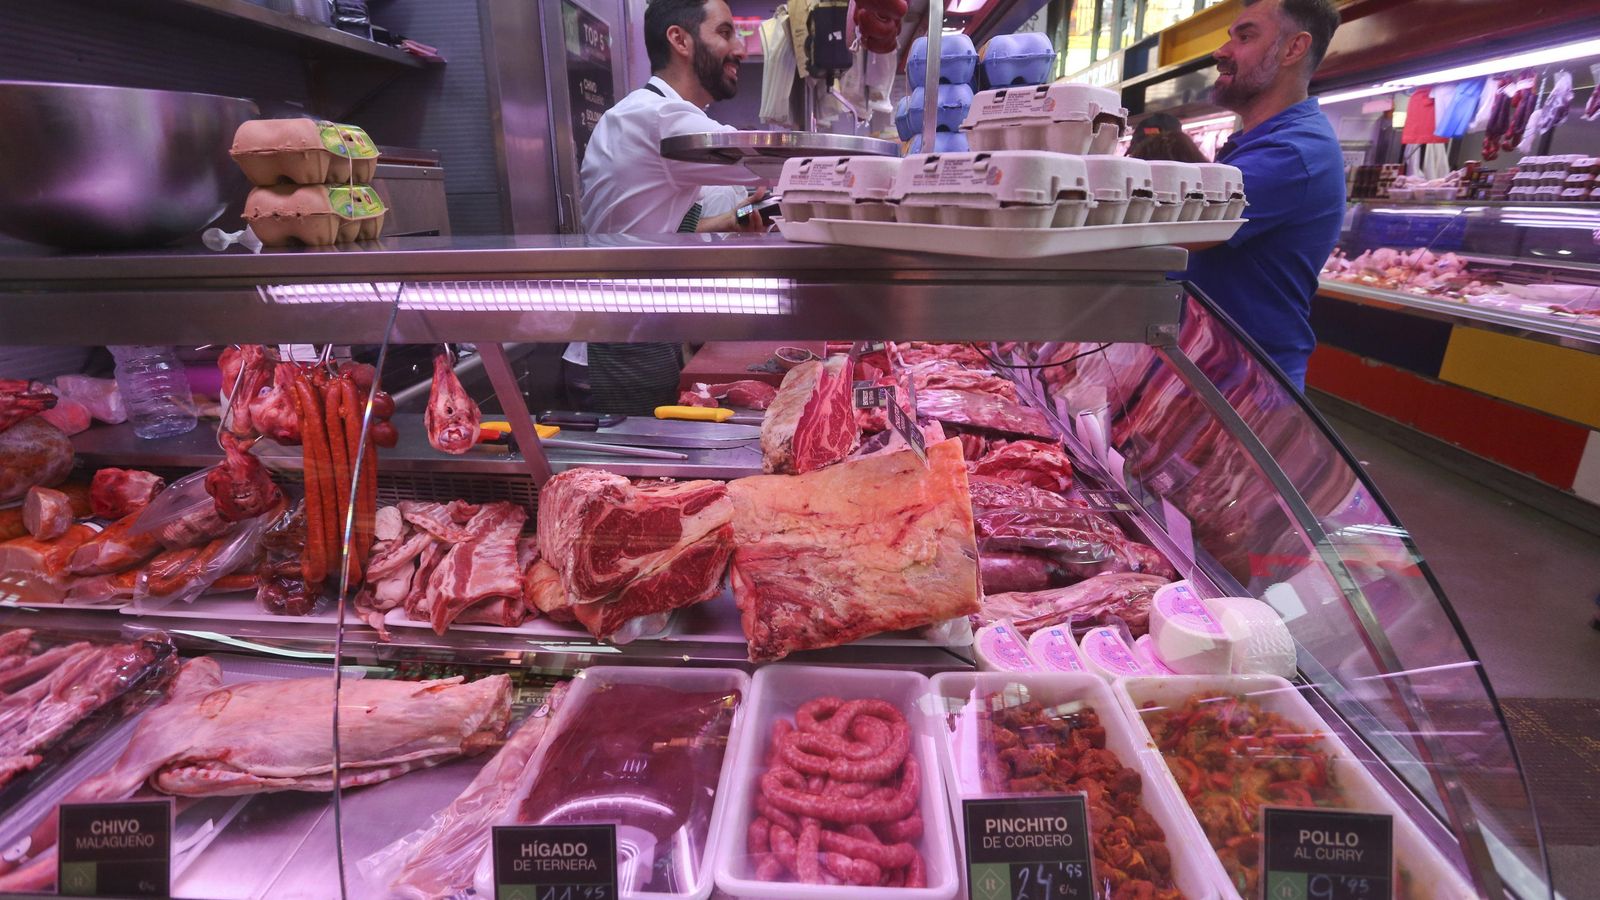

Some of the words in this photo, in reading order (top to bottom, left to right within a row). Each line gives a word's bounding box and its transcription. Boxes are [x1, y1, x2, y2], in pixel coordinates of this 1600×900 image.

[583, 23, 599, 47] TOP
[599, 33, 605, 51] 5
[90, 819, 140, 835] CHIVO
[985, 816, 1068, 834] PINCHITO
[75, 832, 155, 850] MALAGUEÑO
[983, 836, 1002, 849] DE
[1004, 834, 1073, 848] CORDERO
[1299, 829, 1360, 847] POLLO
[521, 840, 588, 858] HÍGADO
[1293, 847, 1312, 860] AL
[1315, 847, 1365, 863] CURRY
[513, 859, 532, 871] DE
[534, 859, 598, 871] TERNERA
